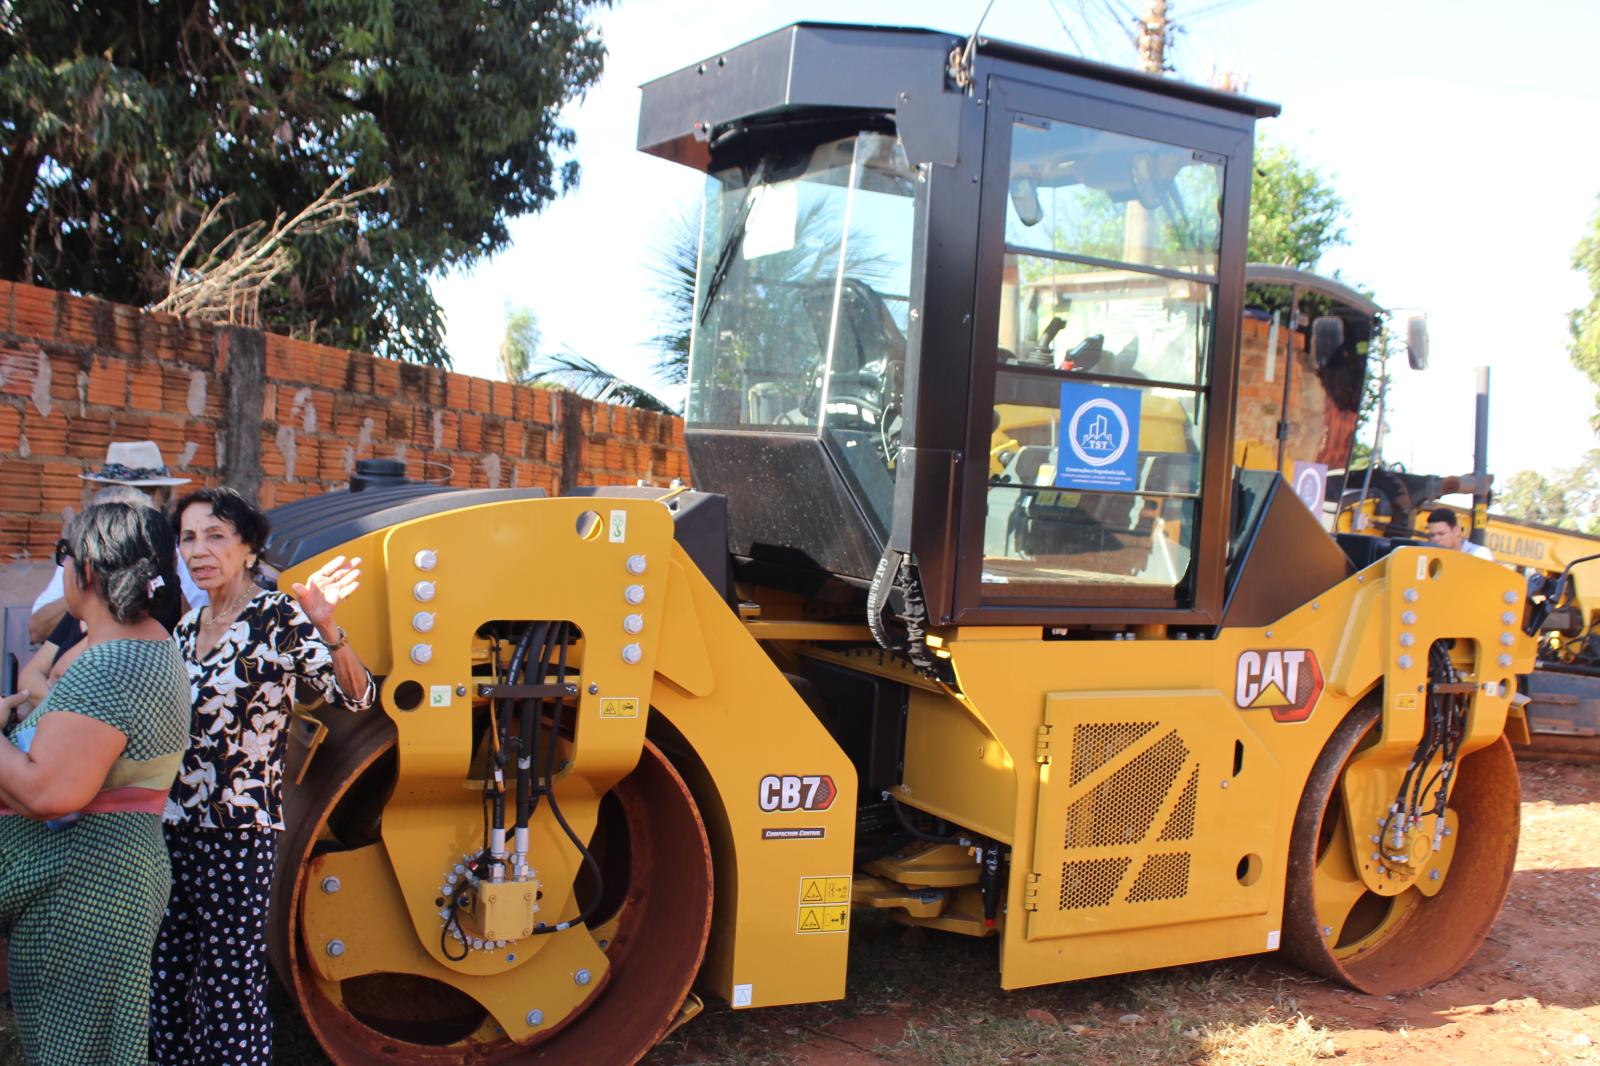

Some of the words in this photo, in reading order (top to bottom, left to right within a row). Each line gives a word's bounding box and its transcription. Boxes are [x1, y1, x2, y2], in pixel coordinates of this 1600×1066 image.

[1090, 440, 1108, 449] TST
[876, 558, 889, 578] CAT
[1236, 650, 1306, 707] CAT
[760, 776, 820, 811] CB7
